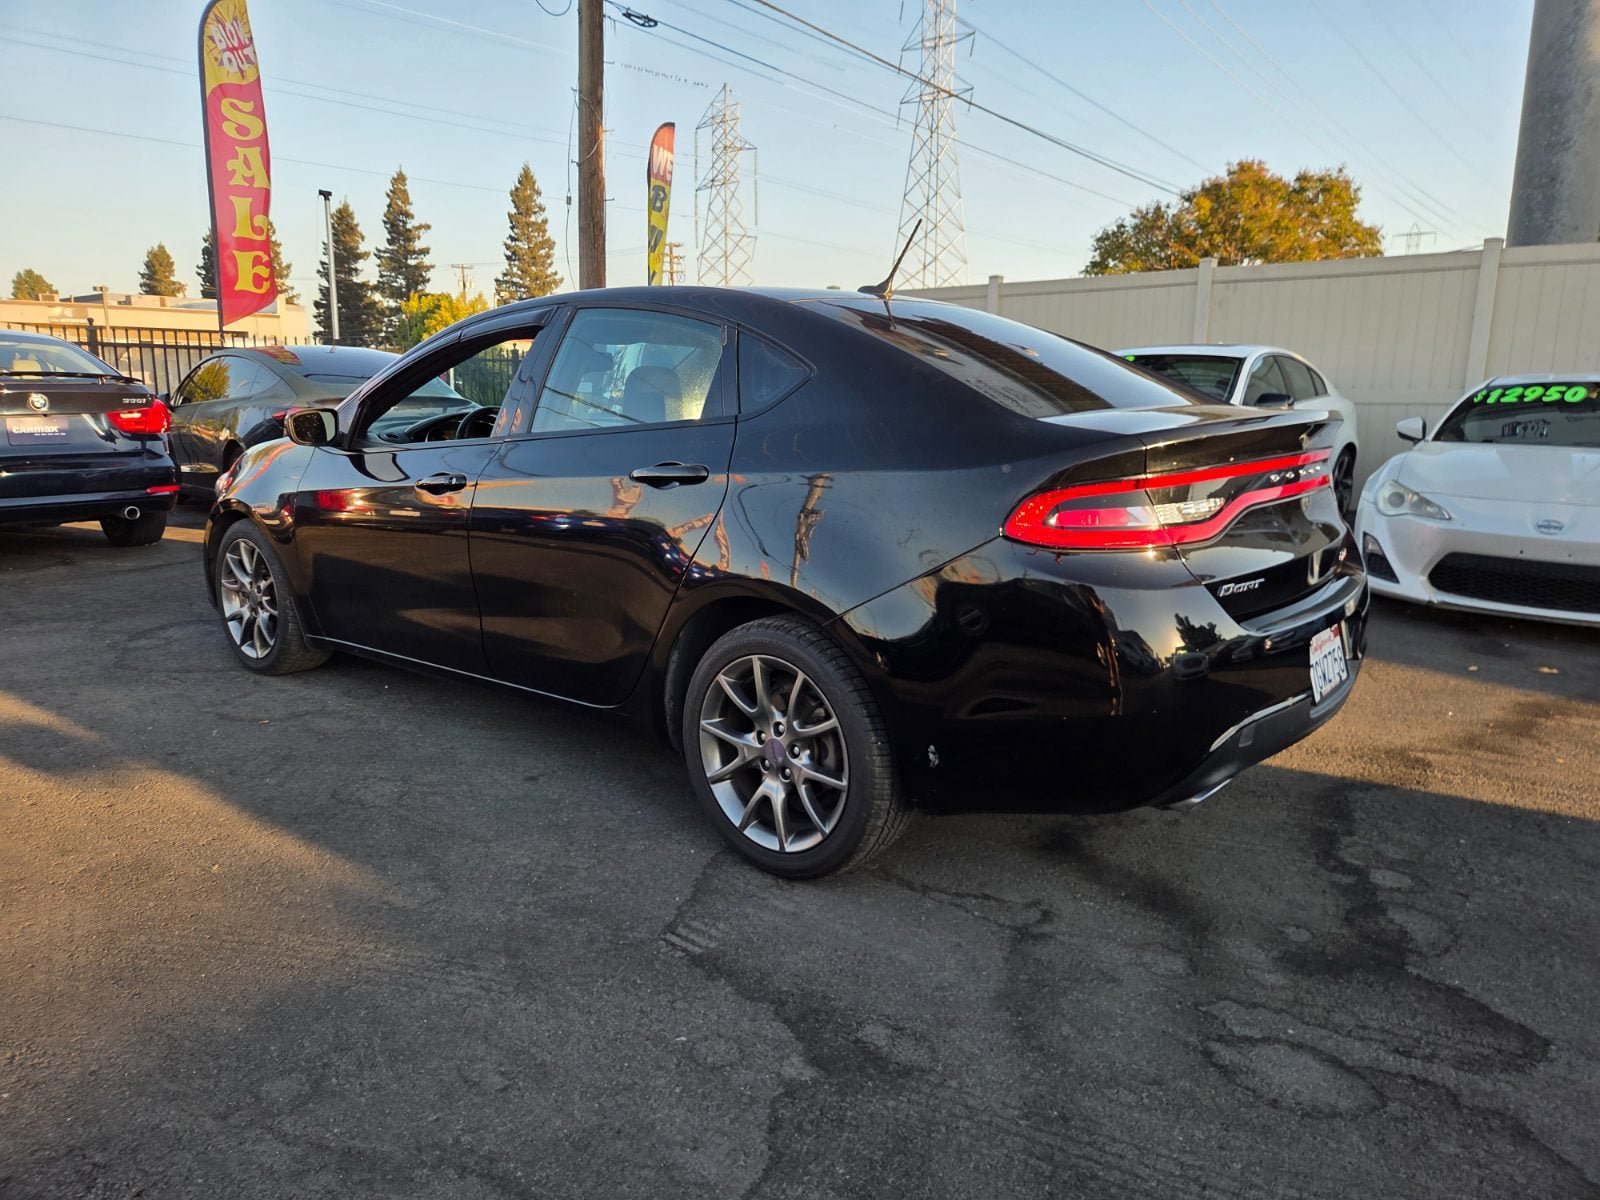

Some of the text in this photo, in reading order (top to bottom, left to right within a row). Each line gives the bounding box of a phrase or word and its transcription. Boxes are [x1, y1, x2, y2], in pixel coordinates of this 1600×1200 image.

[222, 46, 256, 73] OUT
[653, 144, 673, 181] WE
[220, 97, 271, 294] SALE
[1474, 385, 1588, 404] $12950
